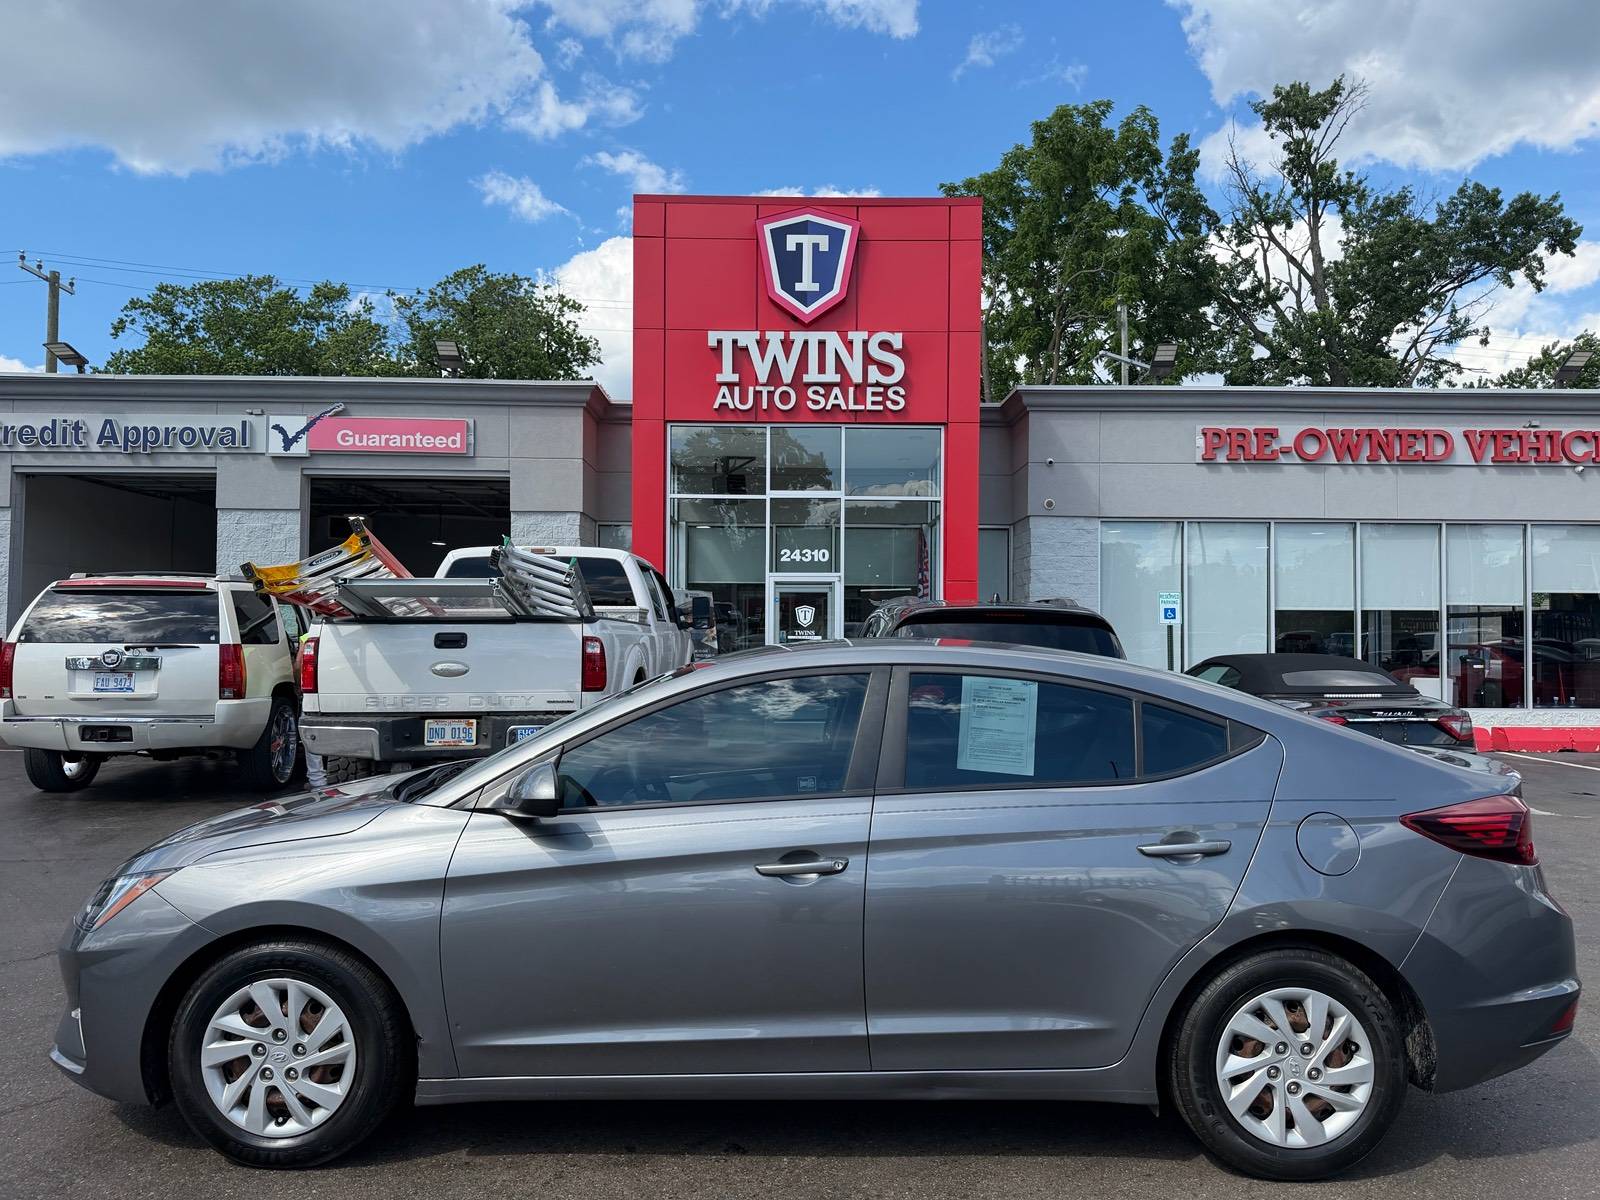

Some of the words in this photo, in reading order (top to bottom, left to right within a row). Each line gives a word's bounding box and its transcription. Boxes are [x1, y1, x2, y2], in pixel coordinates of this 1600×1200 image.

[786, 234, 829, 292] T
[707, 330, 906, 385] TWINS
[712, 385, 797, 411] AUTO
[806, 385, 906, 412] SALES
[0, 418, 86, 447] redit
[96, 418, 251, 454] Approval
[336, 429, 461, 449] Guaranteed
[1201, 427, 1455, 463] PRE-OWNED
[1463, 429, 1600, 465] VEHIC
[780, 548, 830, 562] 24310
[95, 677, 110, 688] FAU
[365, 695, 450, 709] SUPER
[468, 695, 535, 708] DUTY
[451, 727, 473, 740] 0196
